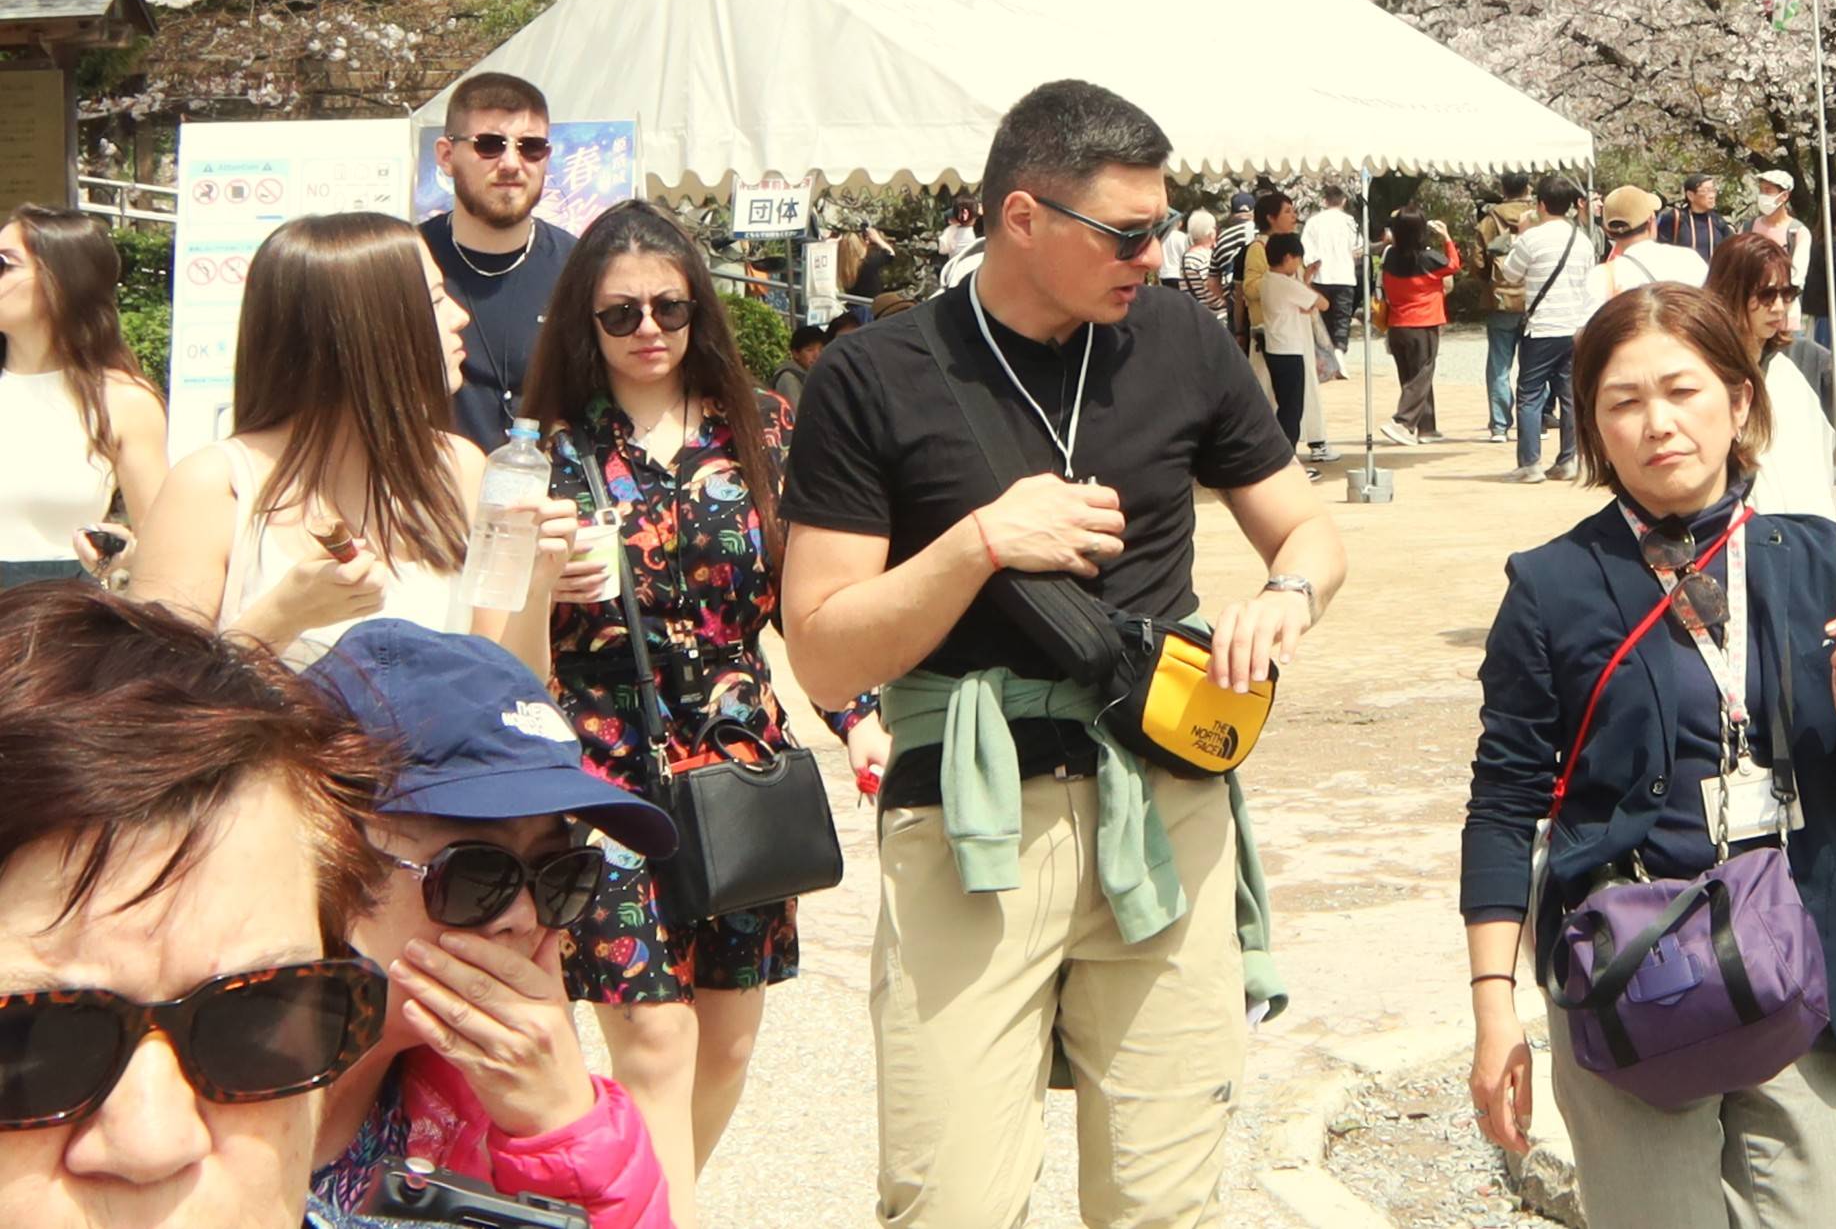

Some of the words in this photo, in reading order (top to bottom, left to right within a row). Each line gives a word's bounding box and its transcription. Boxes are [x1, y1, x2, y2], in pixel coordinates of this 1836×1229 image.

[748, 197, 800, 225] 団体
[1190, 724, 1224, 743] NORTH
[1213, 719, 1230, 734] THE
